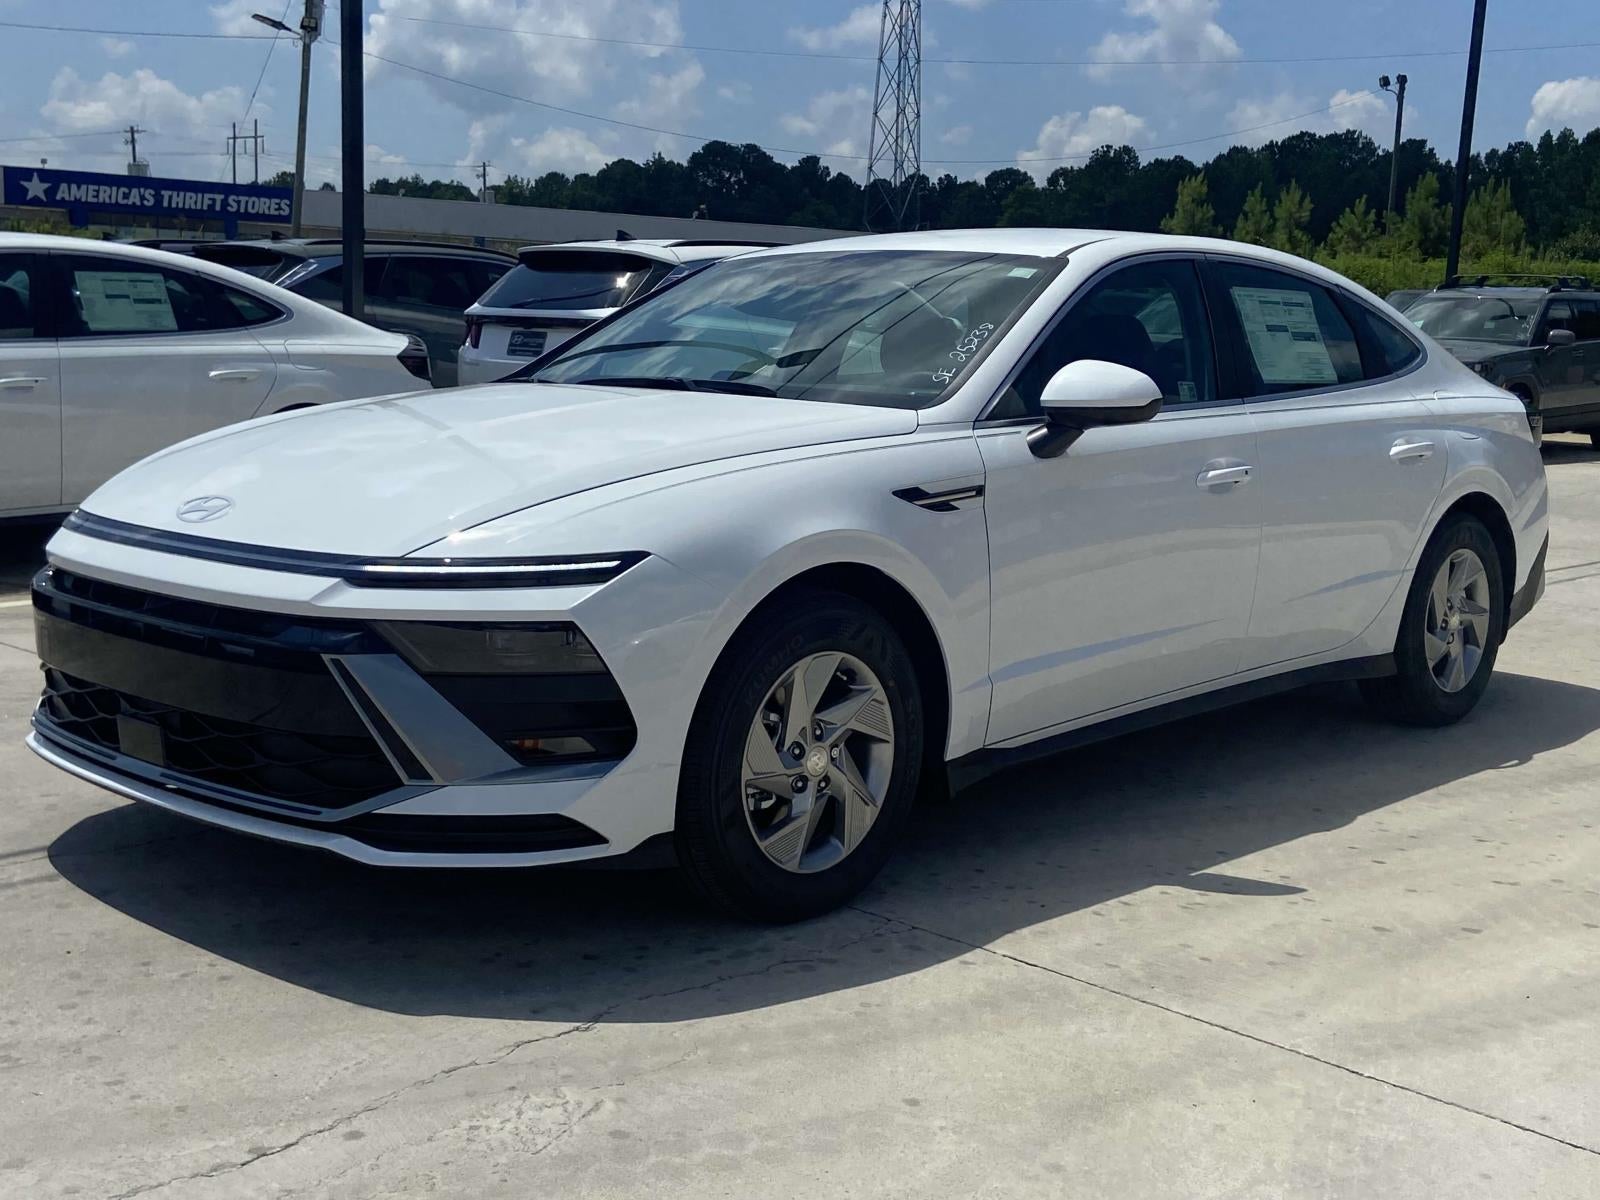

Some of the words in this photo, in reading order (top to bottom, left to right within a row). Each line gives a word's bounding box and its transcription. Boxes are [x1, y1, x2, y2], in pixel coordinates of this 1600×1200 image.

[56, 183, 155, 206] AMERICA'S
[161, 190, 224, 211] THRIFT
[227, 195, 290, 216] STORES
[932, 367, 956, 384] SE
